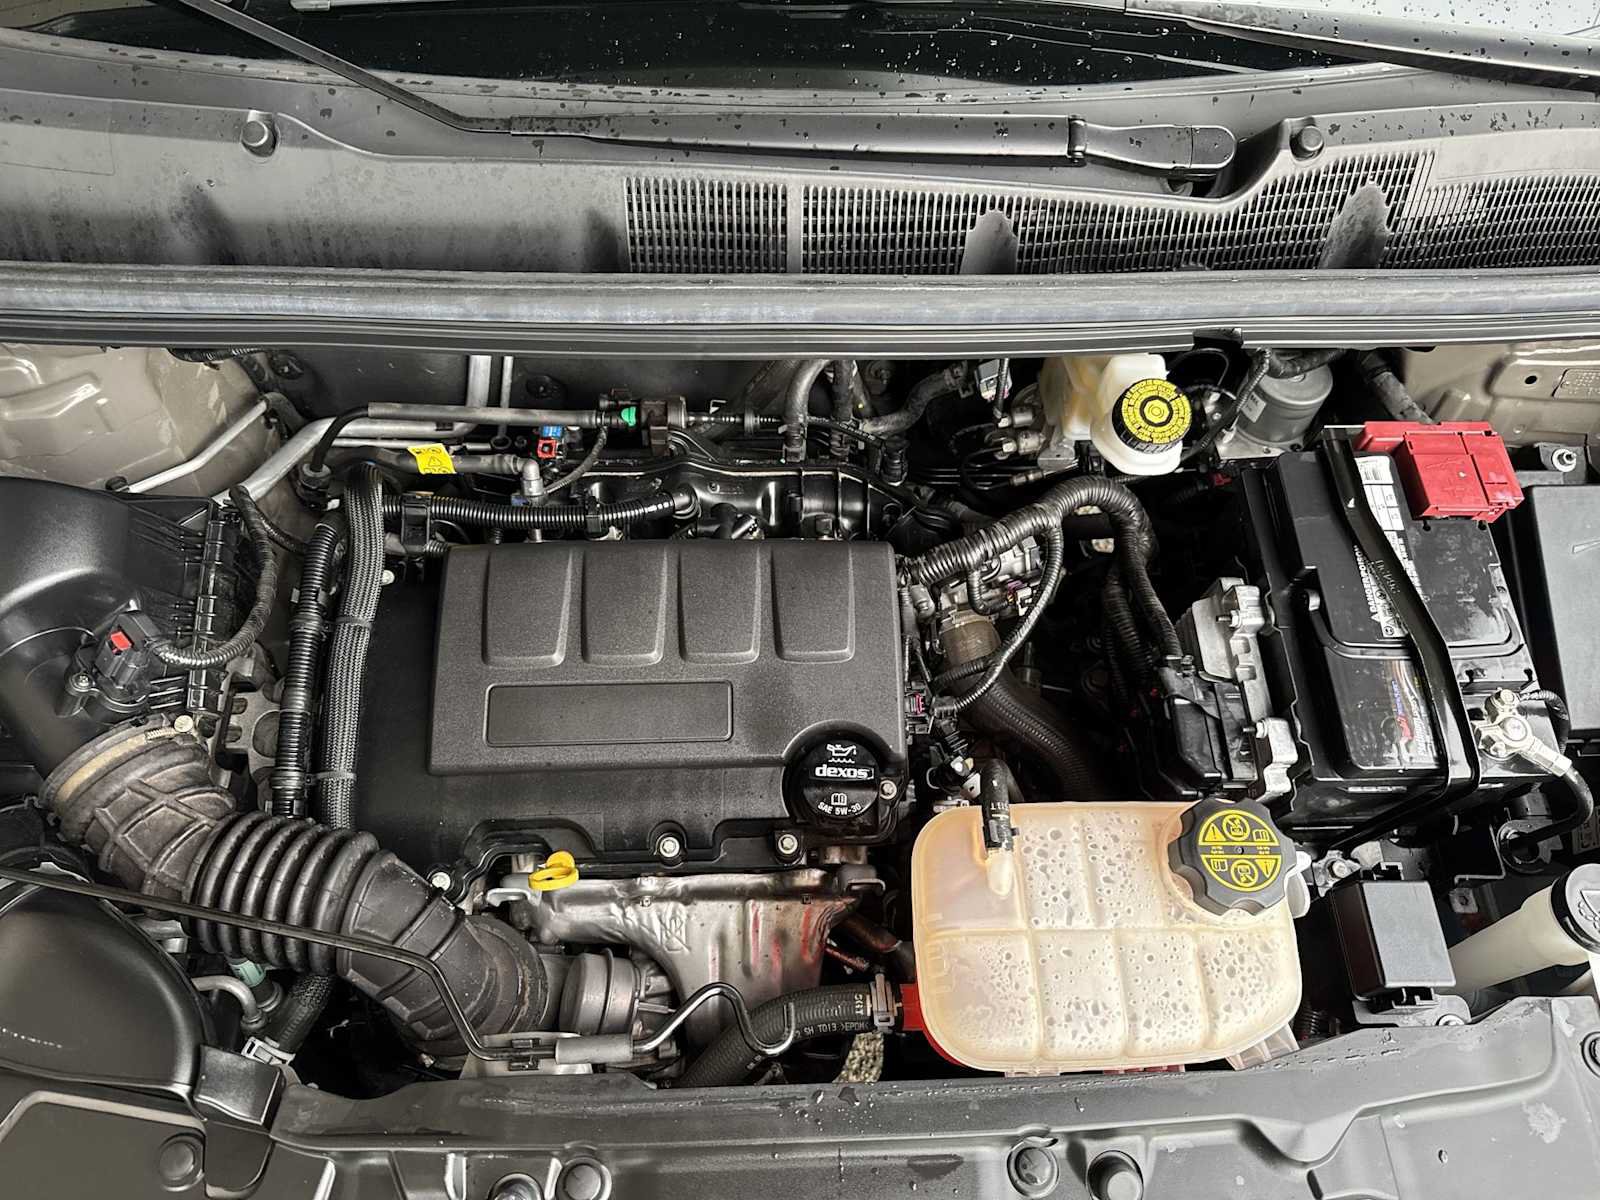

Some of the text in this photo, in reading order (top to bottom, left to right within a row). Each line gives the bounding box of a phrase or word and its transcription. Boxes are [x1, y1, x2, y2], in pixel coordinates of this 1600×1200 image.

[815, 763, 870, 779] dexos
[817, 801, 862, 816] SAE 5W-30
